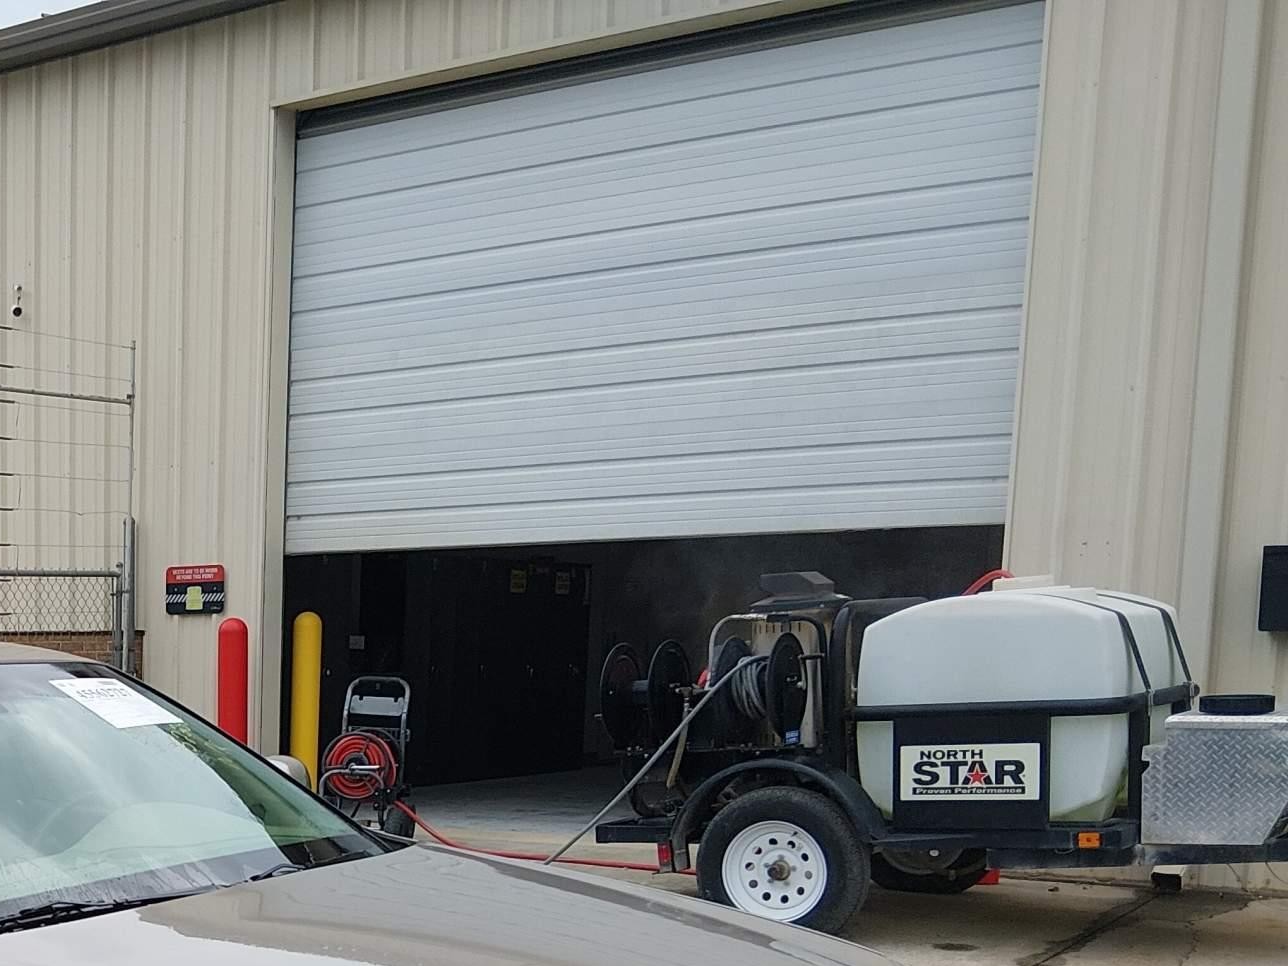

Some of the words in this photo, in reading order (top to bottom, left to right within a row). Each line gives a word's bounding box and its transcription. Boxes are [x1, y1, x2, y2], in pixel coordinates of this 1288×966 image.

[919, 749, 984, 761] NORTH
[912, 760, 1025, 786] STAR
[915, 787, 952, 795] Proven
